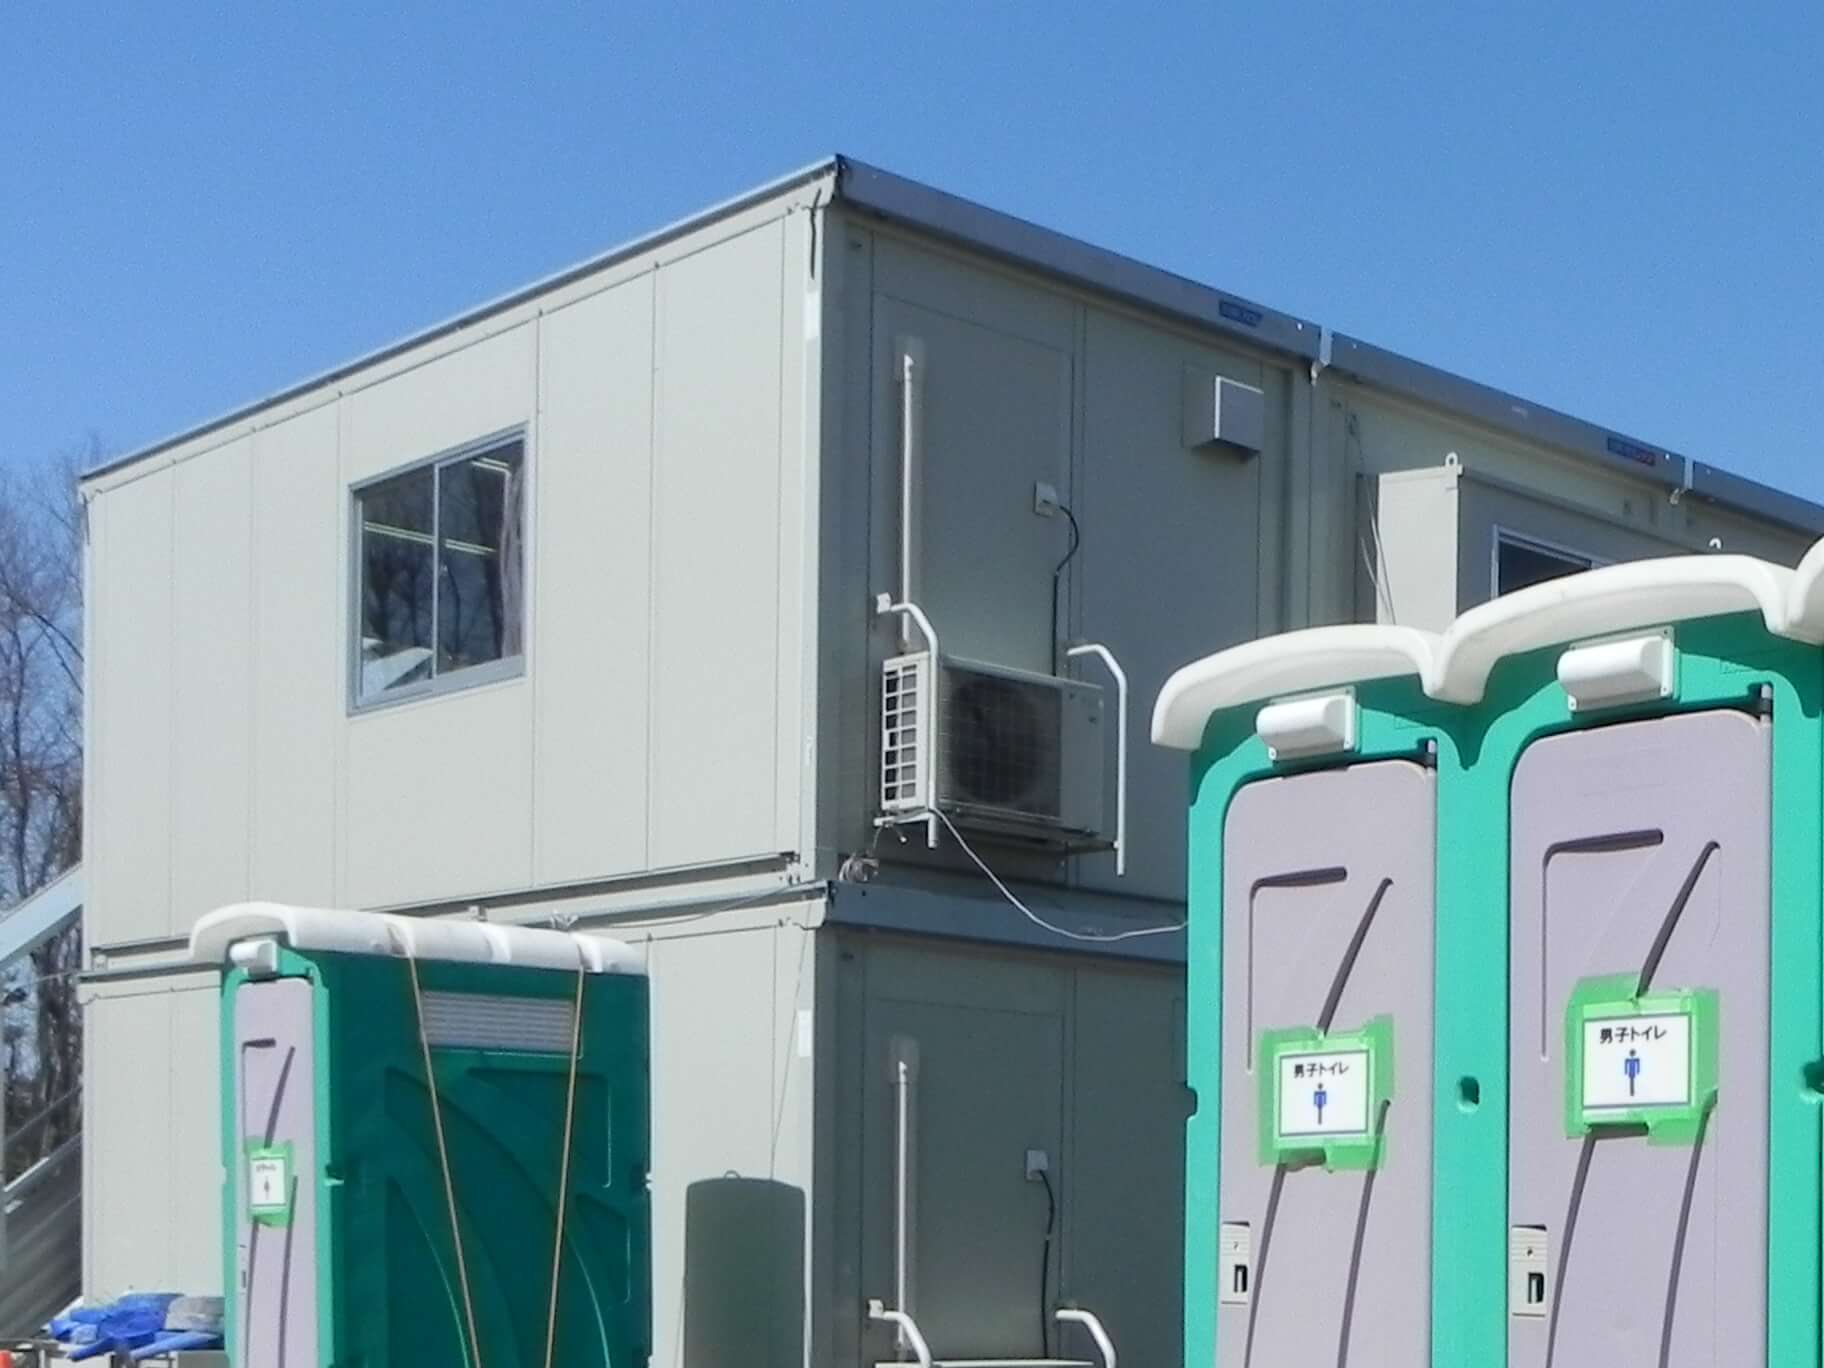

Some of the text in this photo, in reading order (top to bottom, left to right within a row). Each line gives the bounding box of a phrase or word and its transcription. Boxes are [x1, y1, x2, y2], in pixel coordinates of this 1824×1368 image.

[1600, 1025, 1667, 1044] 男子トイレ
[1294, 1061, 1349, 1079] 男子トイレ
